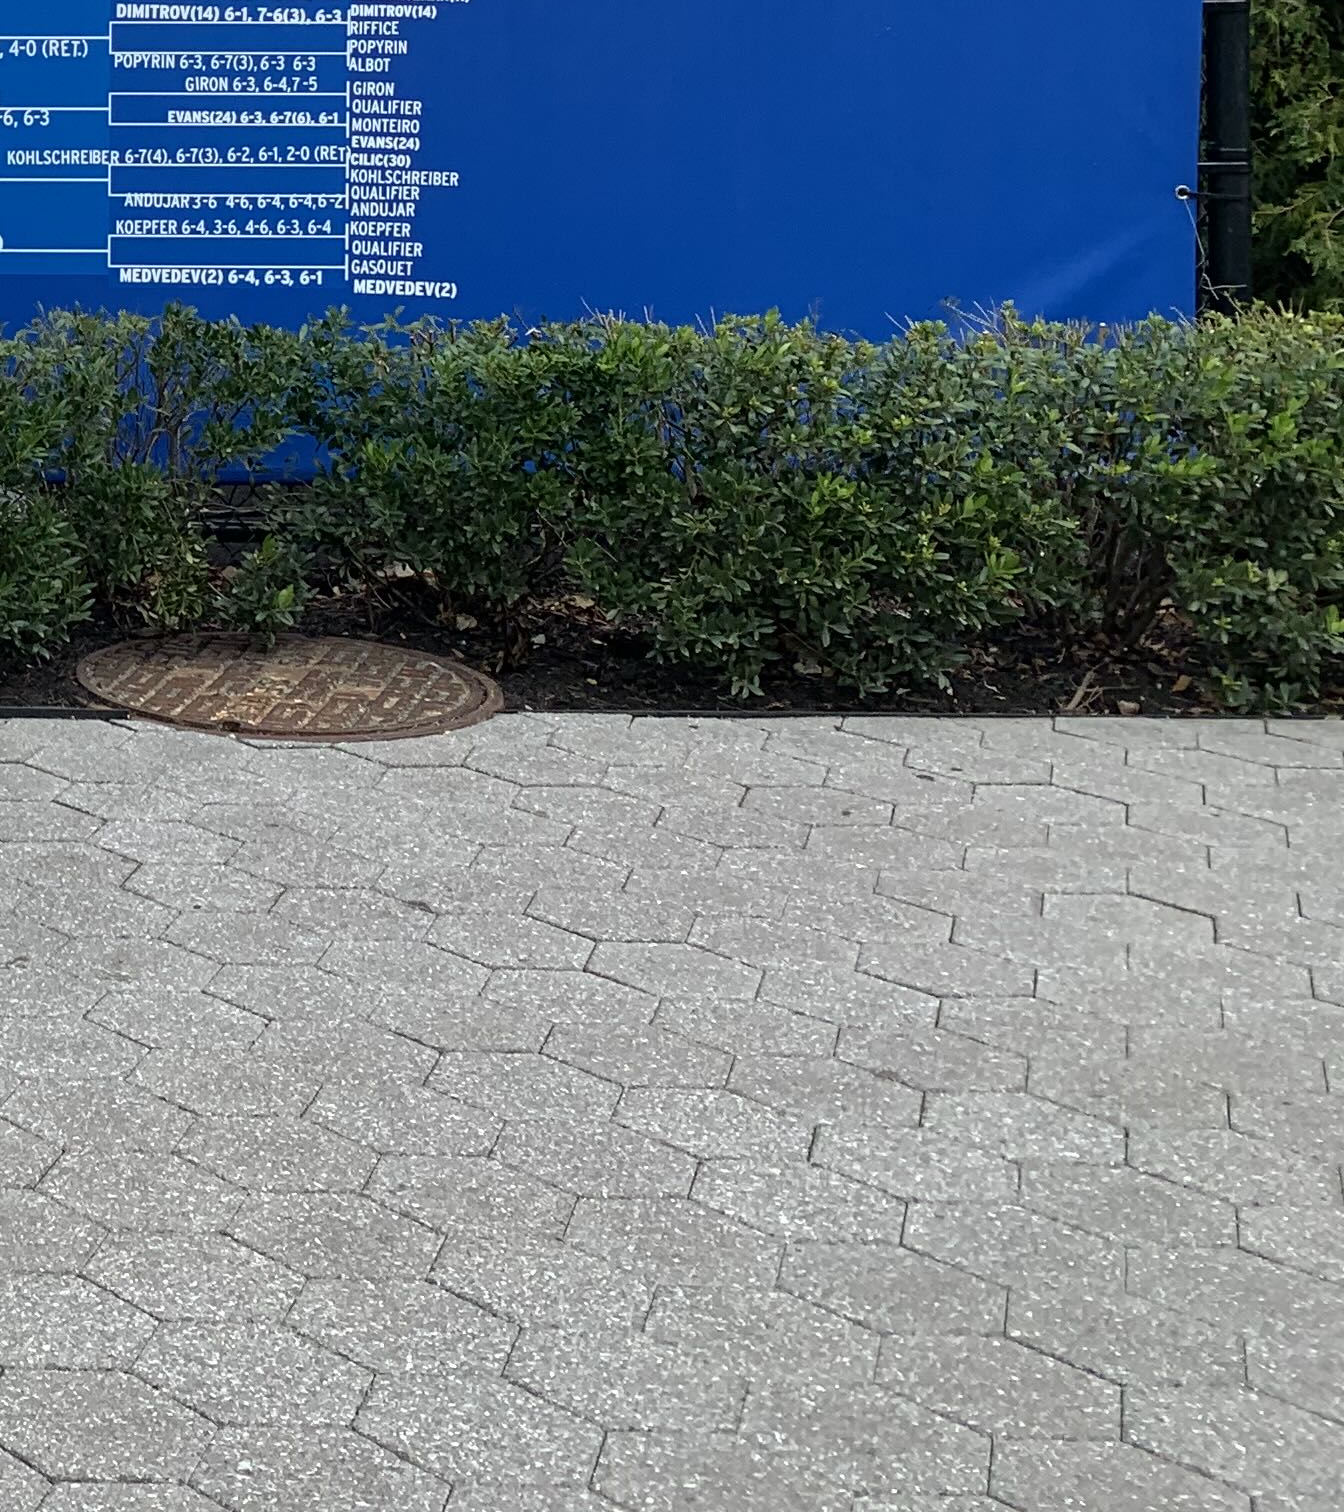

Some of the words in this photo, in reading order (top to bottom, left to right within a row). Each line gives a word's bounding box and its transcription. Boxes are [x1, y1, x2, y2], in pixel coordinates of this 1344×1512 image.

[350, 3, 438, 20] DIMITROV(14)
[351, 117, 420, 134] MONTEIRO
[350, 168, 459, 188] KOHLSCHREIBER
[350, 220, 411, 238] KOEPFER
[353, 278, 458, 299] MEDVEDEV(2)
